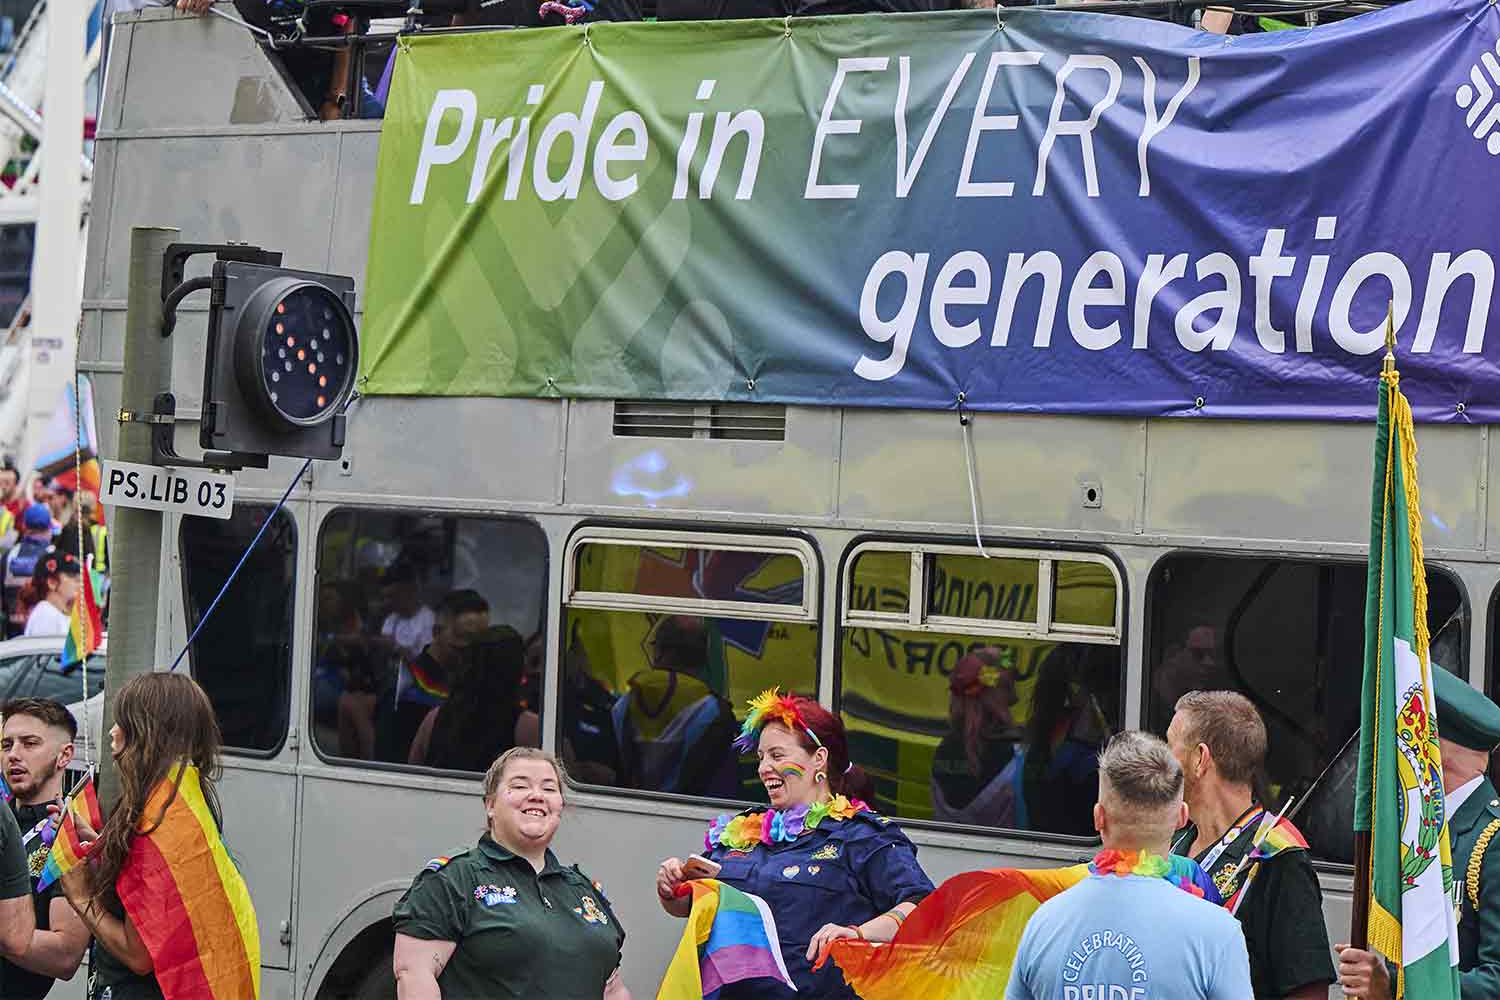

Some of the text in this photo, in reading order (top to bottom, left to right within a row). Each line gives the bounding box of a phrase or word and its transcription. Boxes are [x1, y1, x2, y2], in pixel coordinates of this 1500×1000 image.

[410, 51, 1201, 205] Pride in EVERY
[853, 216, 1496, 381] generation
[108, 469, 226, 509] PS.LIB 03
[1063, 930, 1148, 982] CELEBRATING
